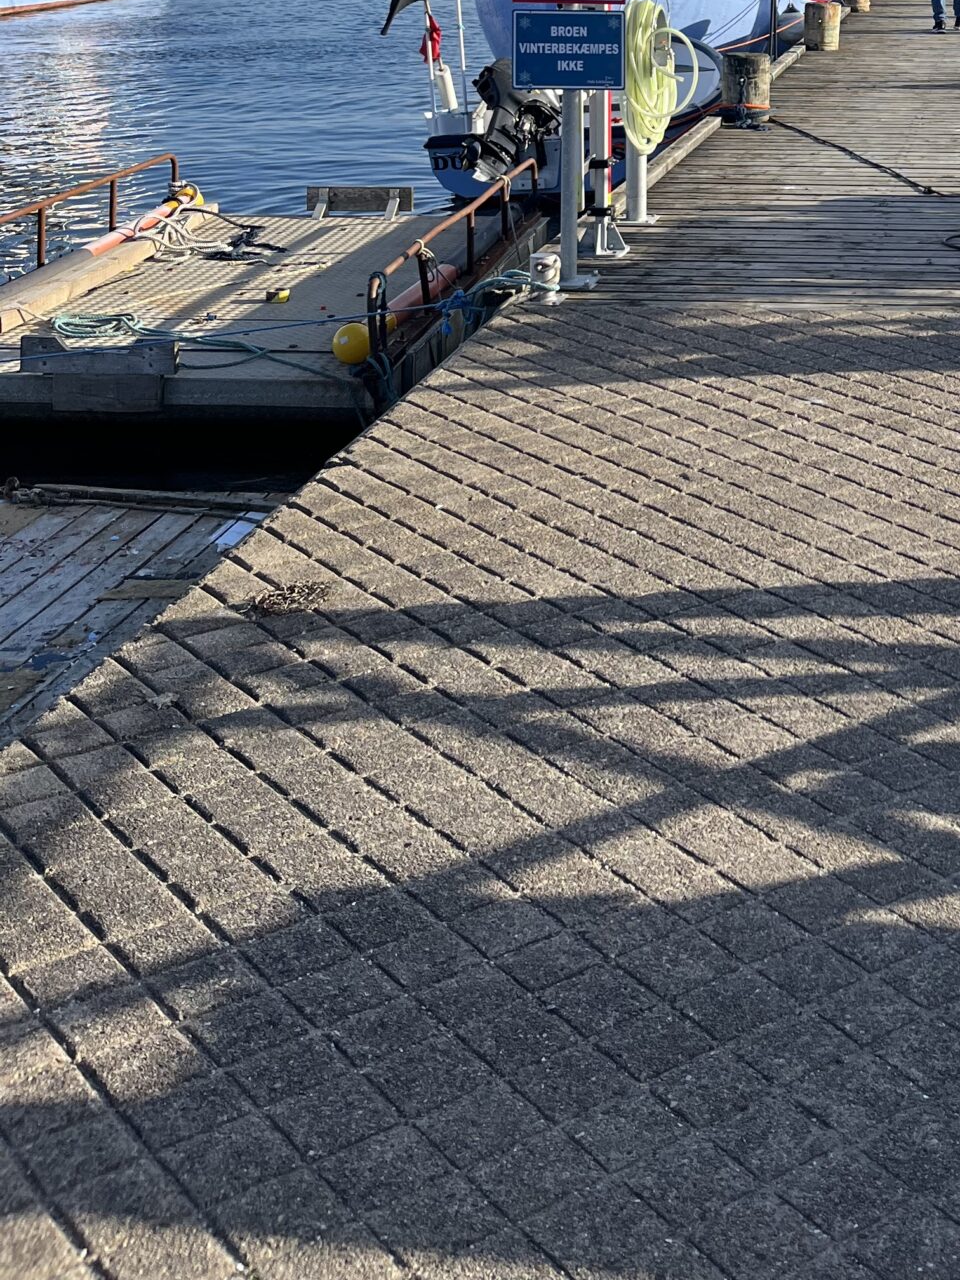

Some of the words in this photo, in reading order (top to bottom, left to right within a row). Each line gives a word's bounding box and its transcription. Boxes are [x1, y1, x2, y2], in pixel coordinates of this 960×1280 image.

[550, 25, 588, 37] BROEN
[519, 42, 619, 55] VINTERBEKÆMPES
[557, 60, 584, 72] IKKE
